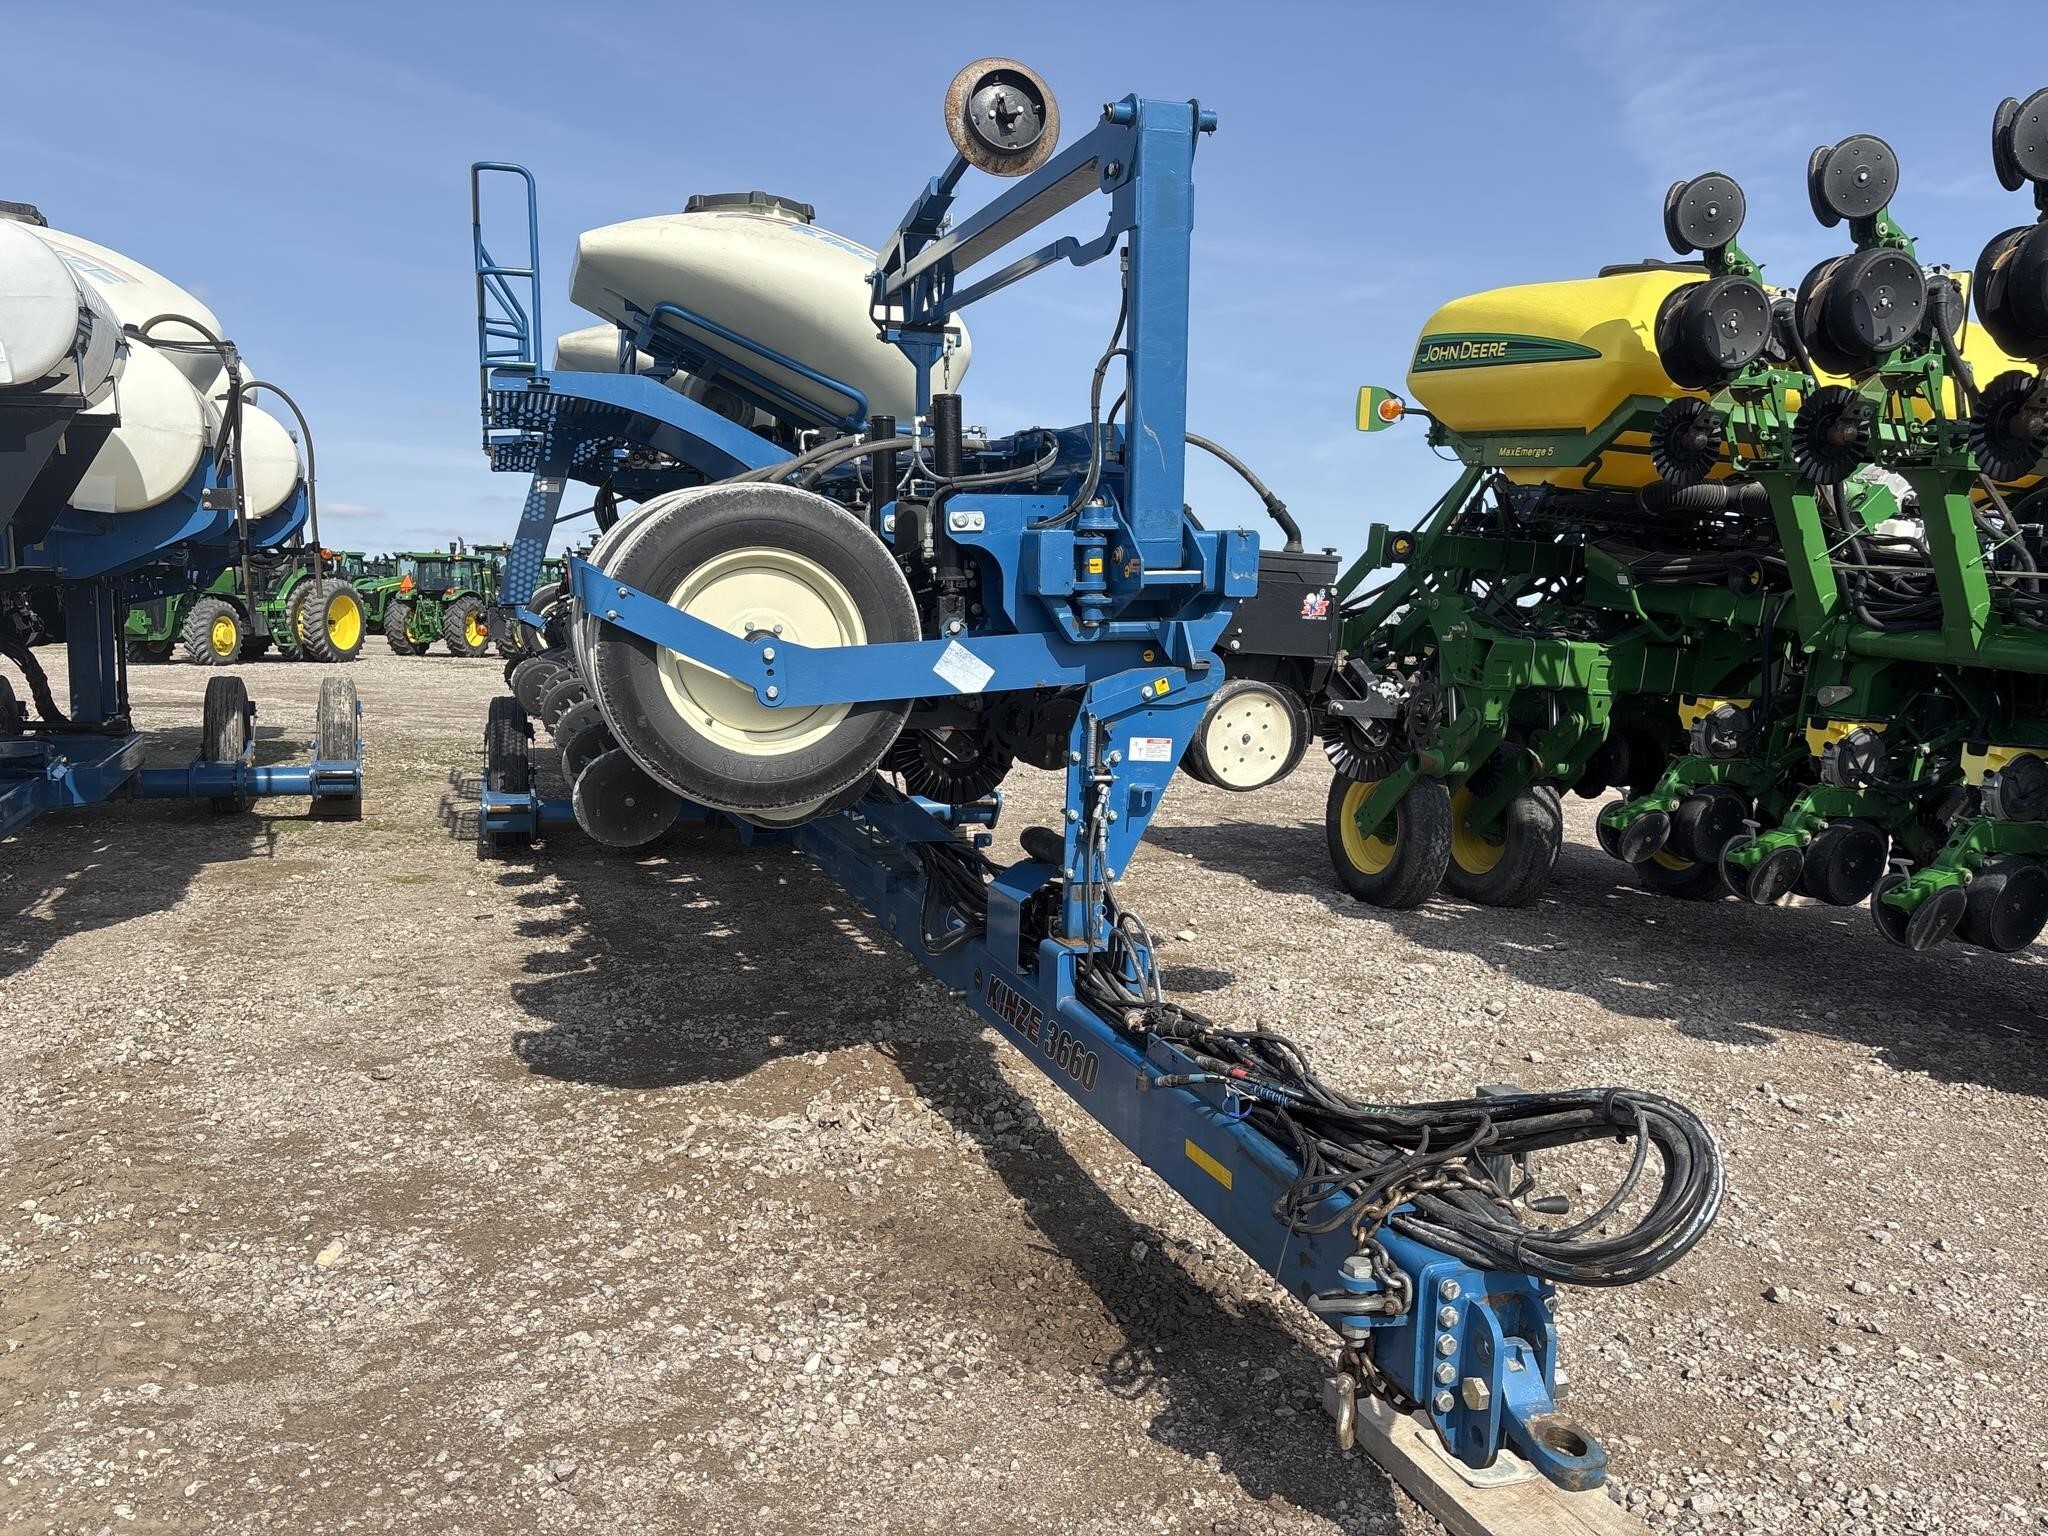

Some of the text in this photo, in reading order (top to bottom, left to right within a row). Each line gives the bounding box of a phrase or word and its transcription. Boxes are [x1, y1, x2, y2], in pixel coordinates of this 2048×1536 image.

[787, 225, 877, 264] KINZ
[1422, 341, 1508, 362] JOHN DEERE
[1498, 446, 1555, 458] MaxEmerge 5
[712, 751, 826, 780] TITAN
[985, 973, 1099, 1092] KINZE 3660
